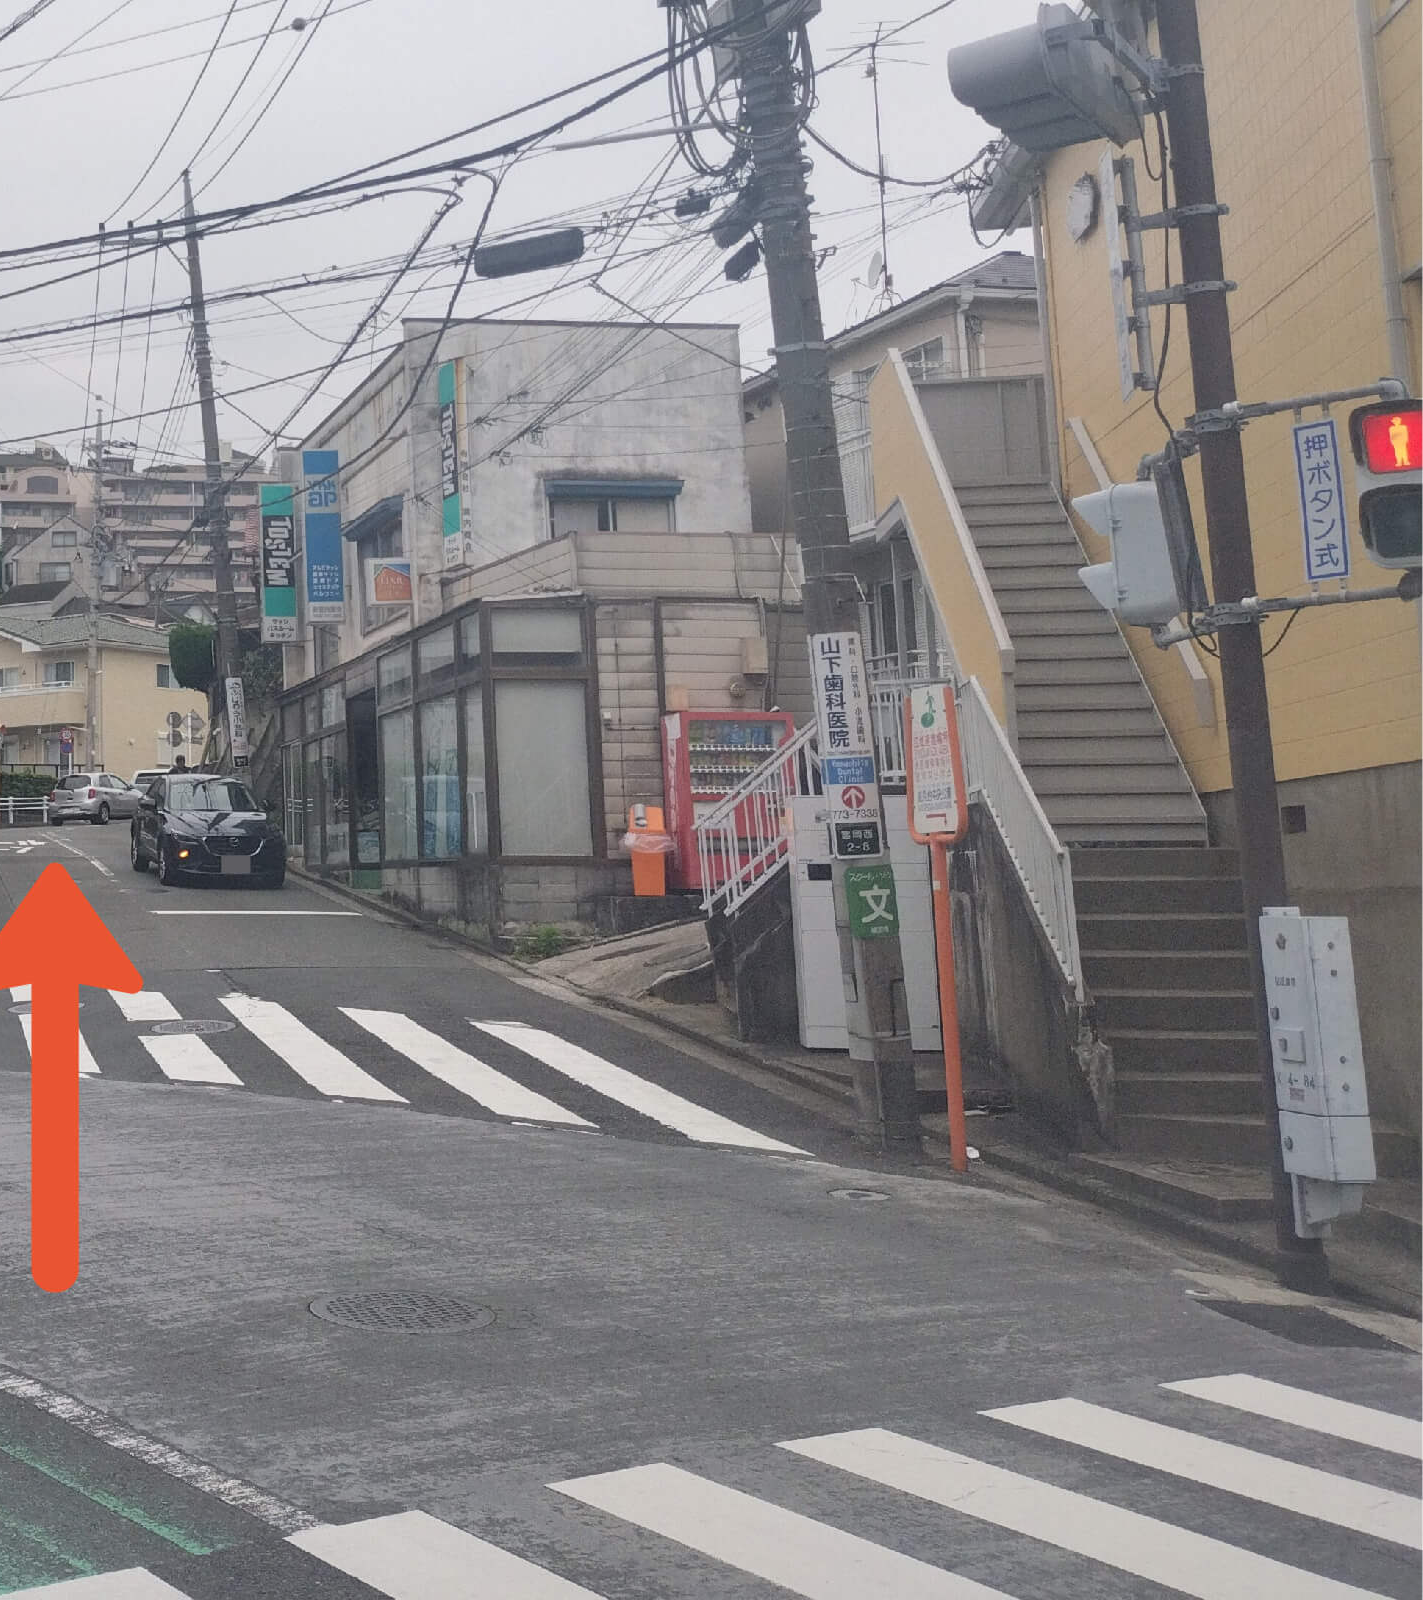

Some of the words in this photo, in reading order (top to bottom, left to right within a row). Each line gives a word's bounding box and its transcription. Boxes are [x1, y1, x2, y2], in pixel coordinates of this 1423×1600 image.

[1303, 433, 1339, 568] 押ボタン式
[265, 516, 292, 586] TOSTEM
[820, 637, 851, 748] 山下歯科医院
[858, 884, 894, 924] 文
